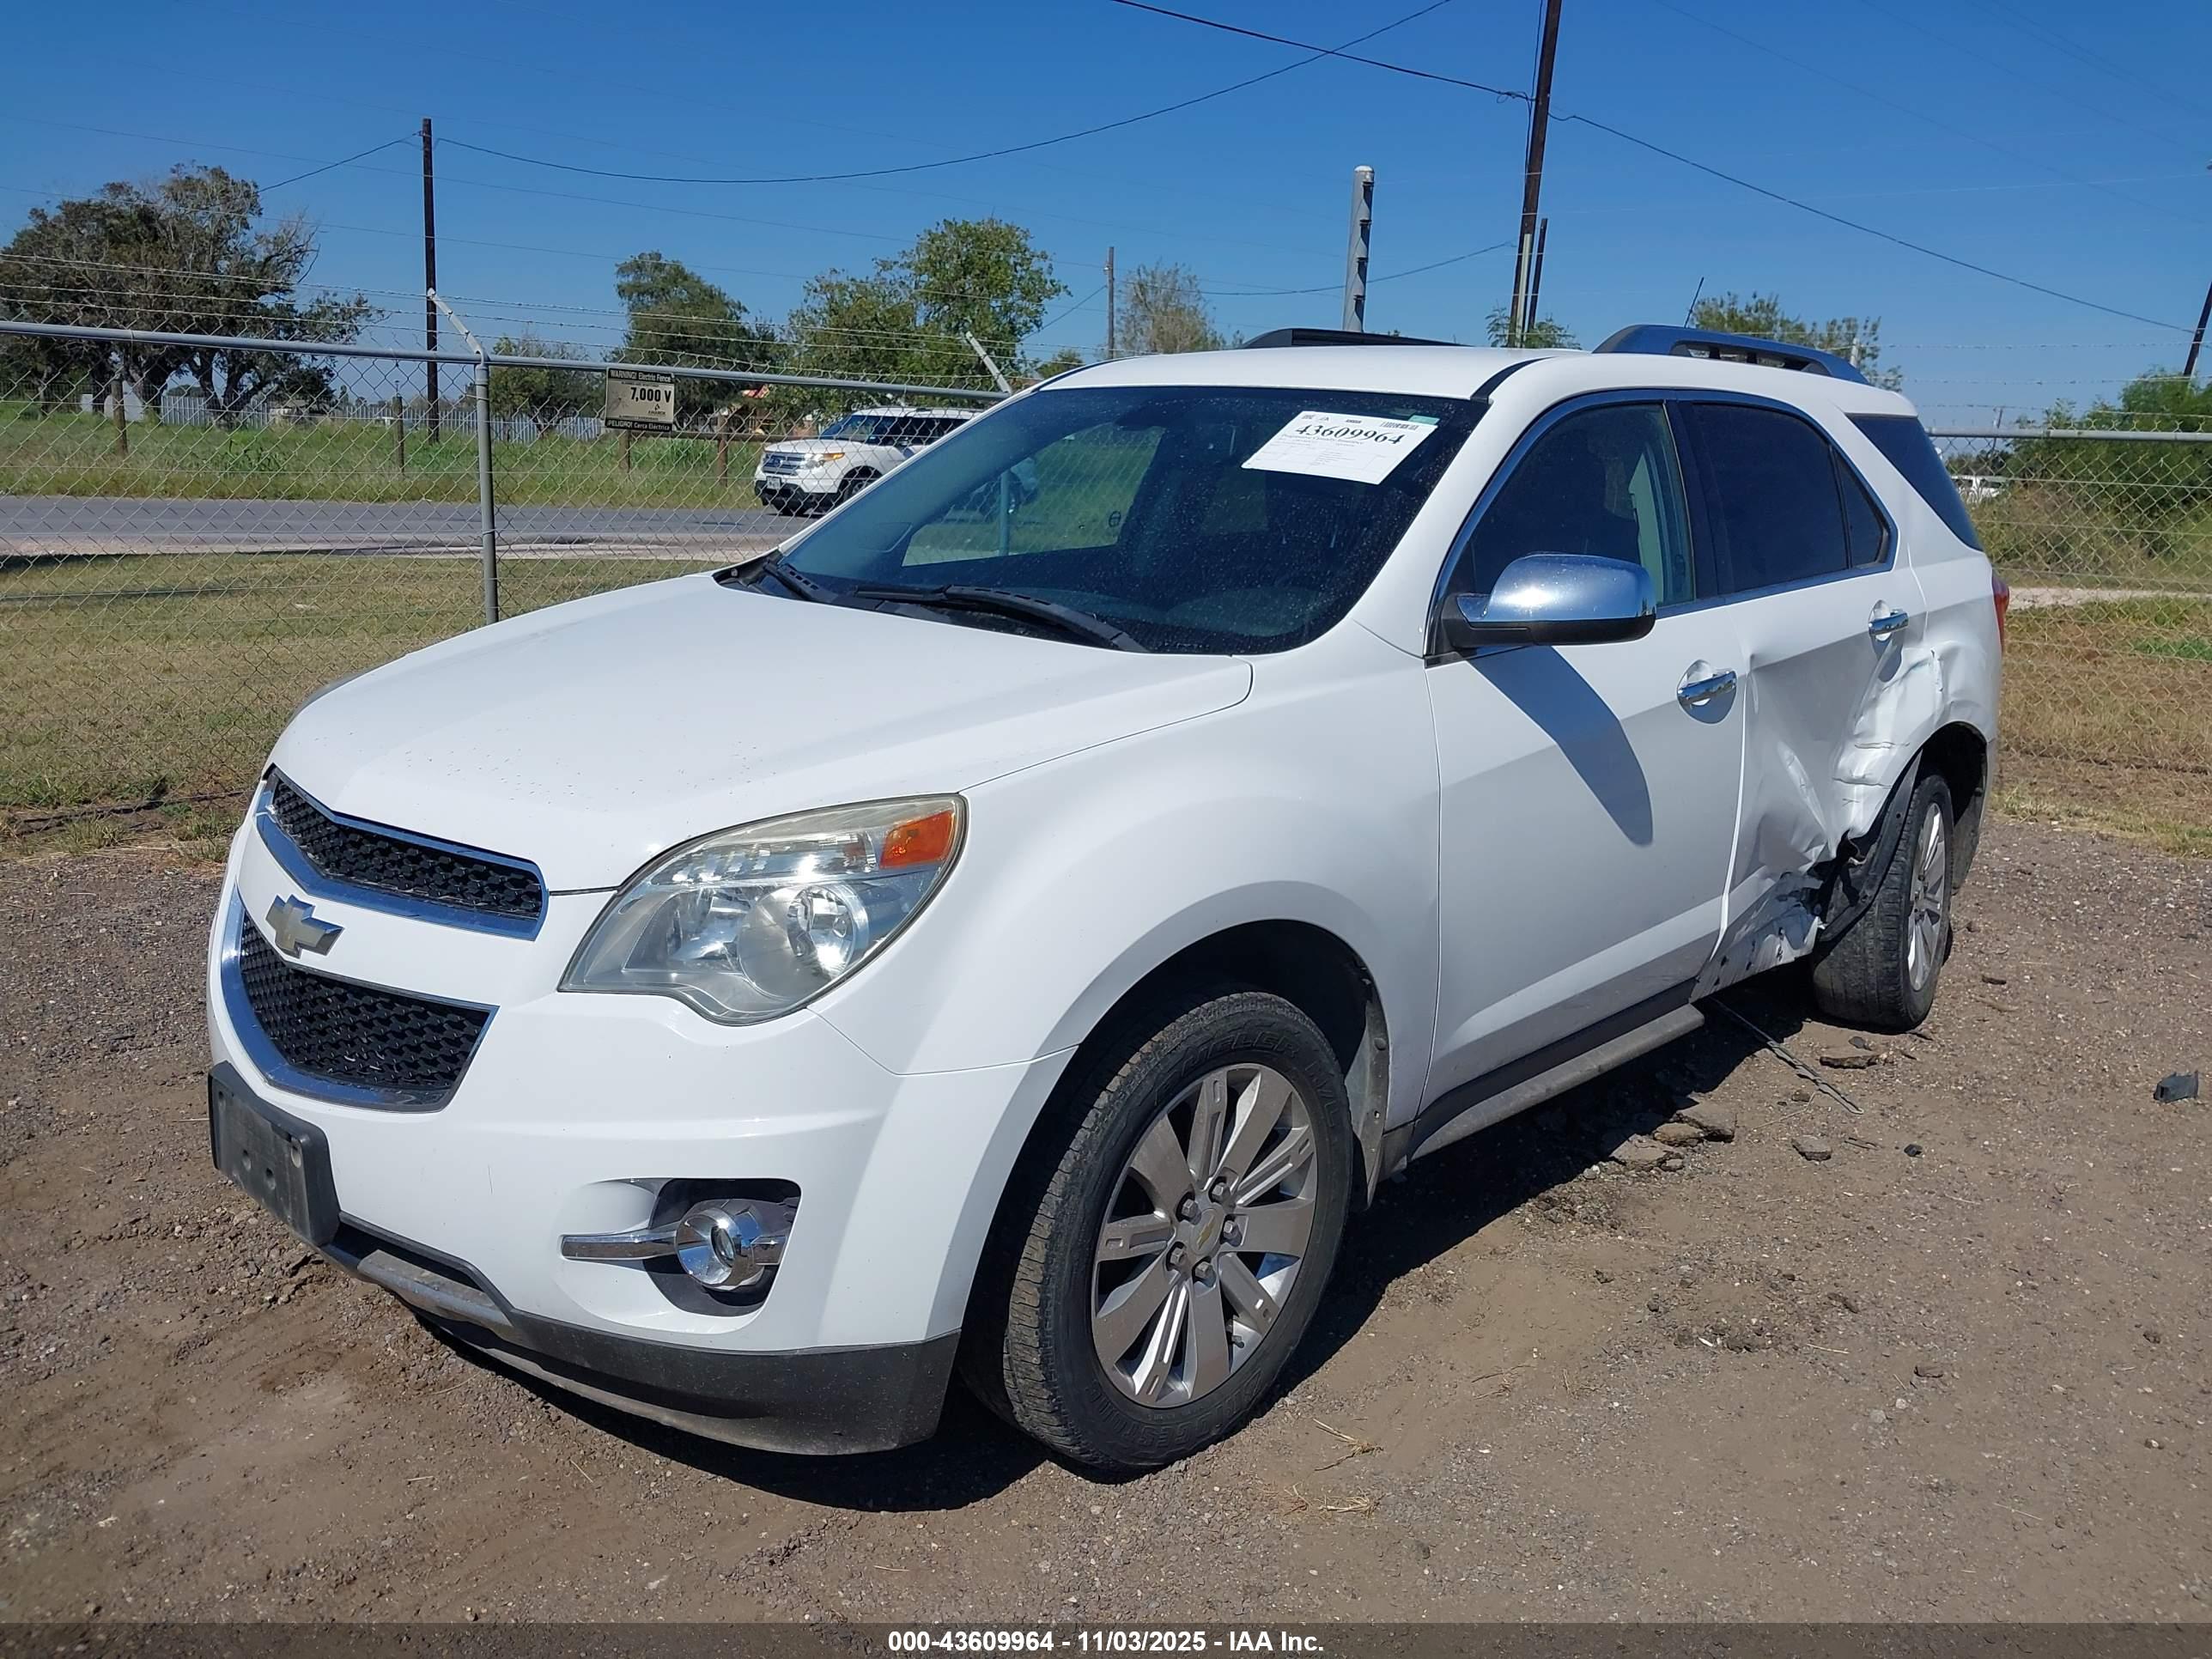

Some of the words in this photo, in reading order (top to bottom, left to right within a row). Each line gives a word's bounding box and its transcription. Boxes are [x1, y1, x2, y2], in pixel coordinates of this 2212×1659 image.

[611, 369, 637, 380] WARNING!
[638, 372, 656, 381] Electric
[657, 374, 672, 383] Fence
[630, 386, 661, 402] 7,000
[665, 390, 672, 403] V
[1295, 423, 1407, 445] 43609964
